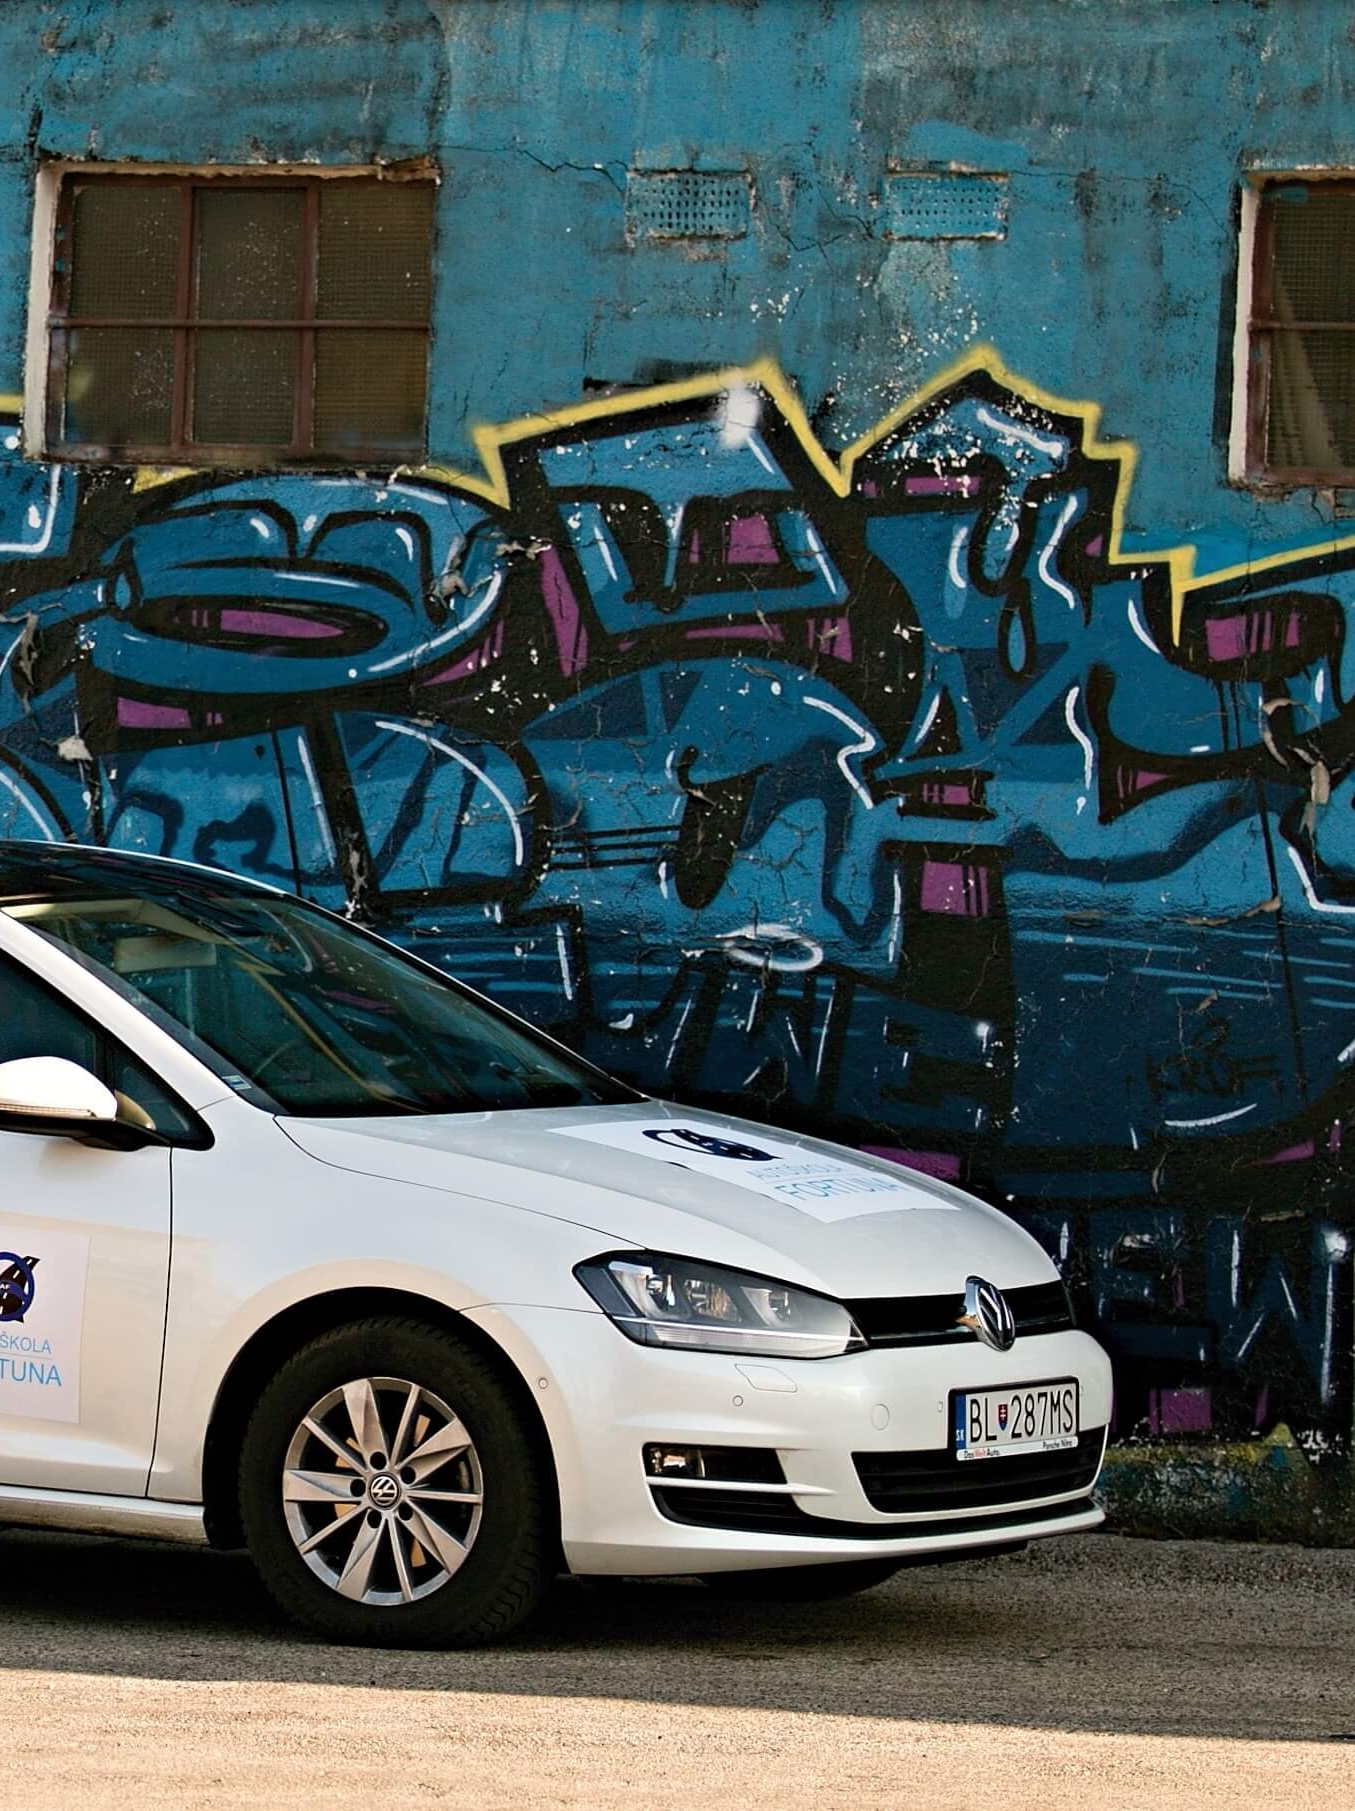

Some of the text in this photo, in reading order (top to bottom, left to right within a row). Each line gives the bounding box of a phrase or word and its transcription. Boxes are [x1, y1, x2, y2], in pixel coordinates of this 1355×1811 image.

[774, 1176, 912, 1202] FORTUNA
[969, 1388, 1074, 1442] BL 287MS
